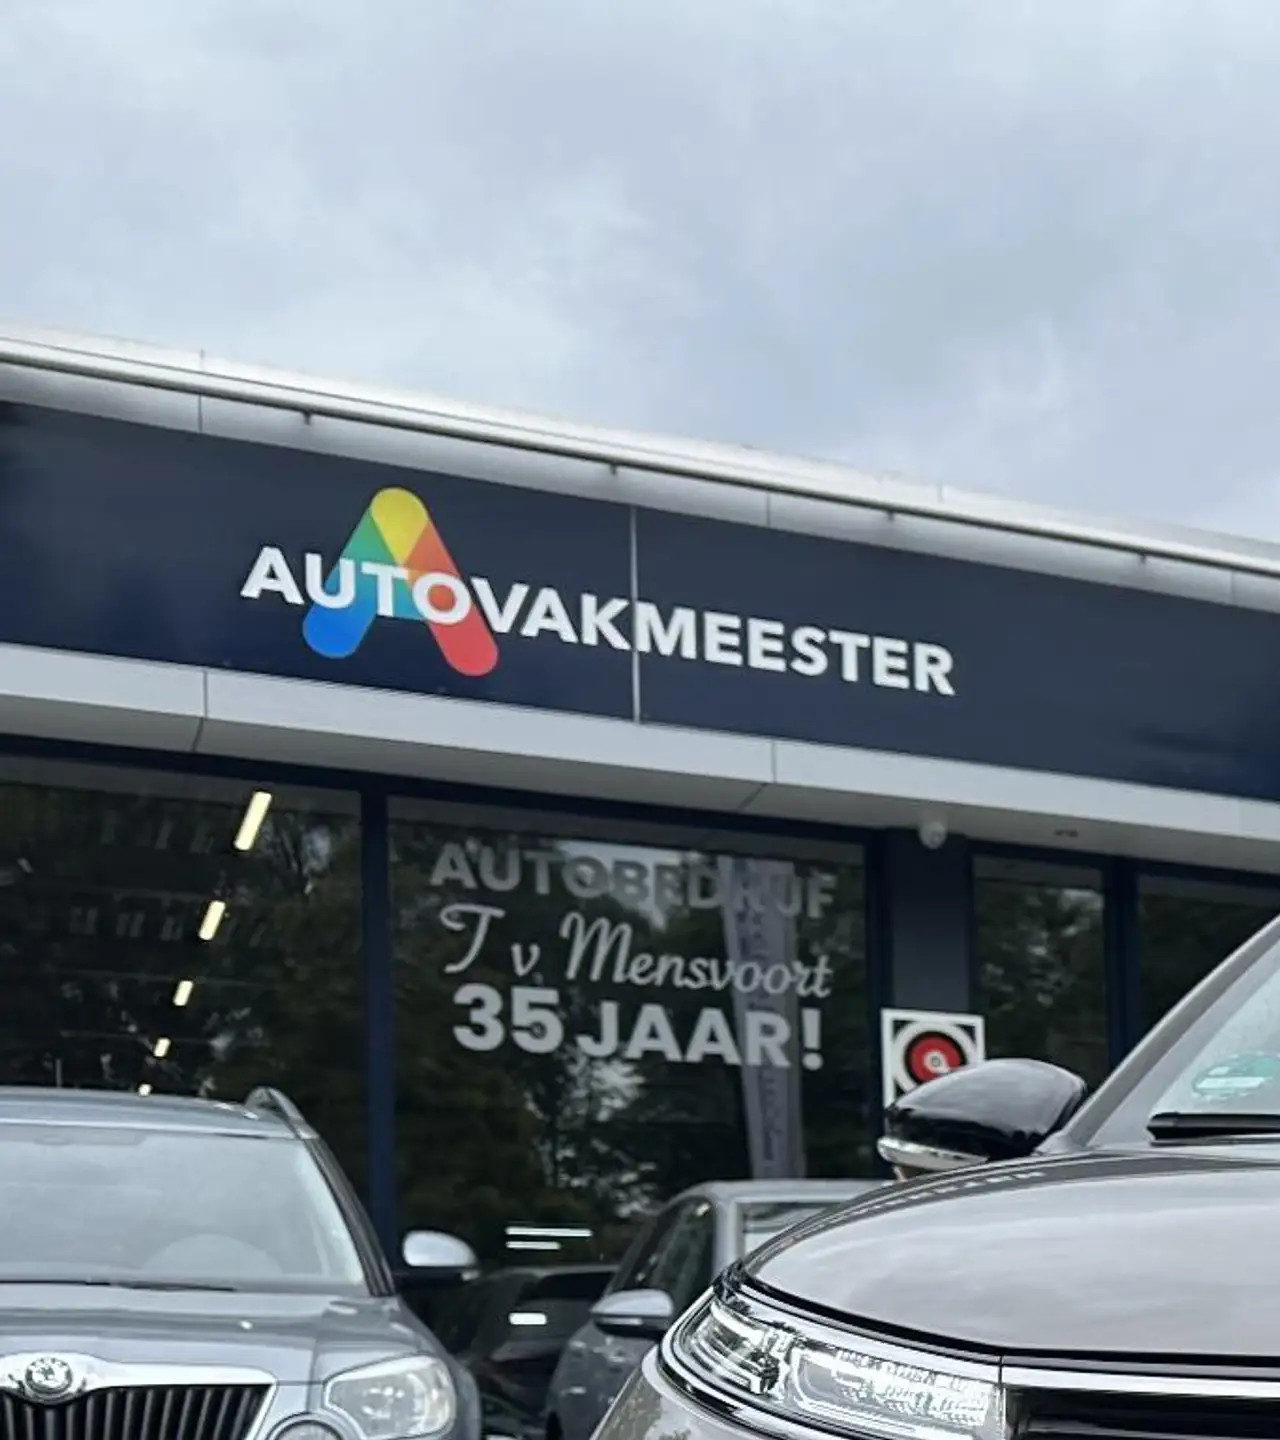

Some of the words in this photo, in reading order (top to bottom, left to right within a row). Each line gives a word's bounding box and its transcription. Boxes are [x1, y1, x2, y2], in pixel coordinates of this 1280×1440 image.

[241, 546, 956, 695] AUTOVAKMEESTER
[440, 903, 506, 974] T
[559, 911, 834, 998] Mensvoort
[452, 983, 564, 1054] 35
[576, 1000, 824, 1070] JAAR!
